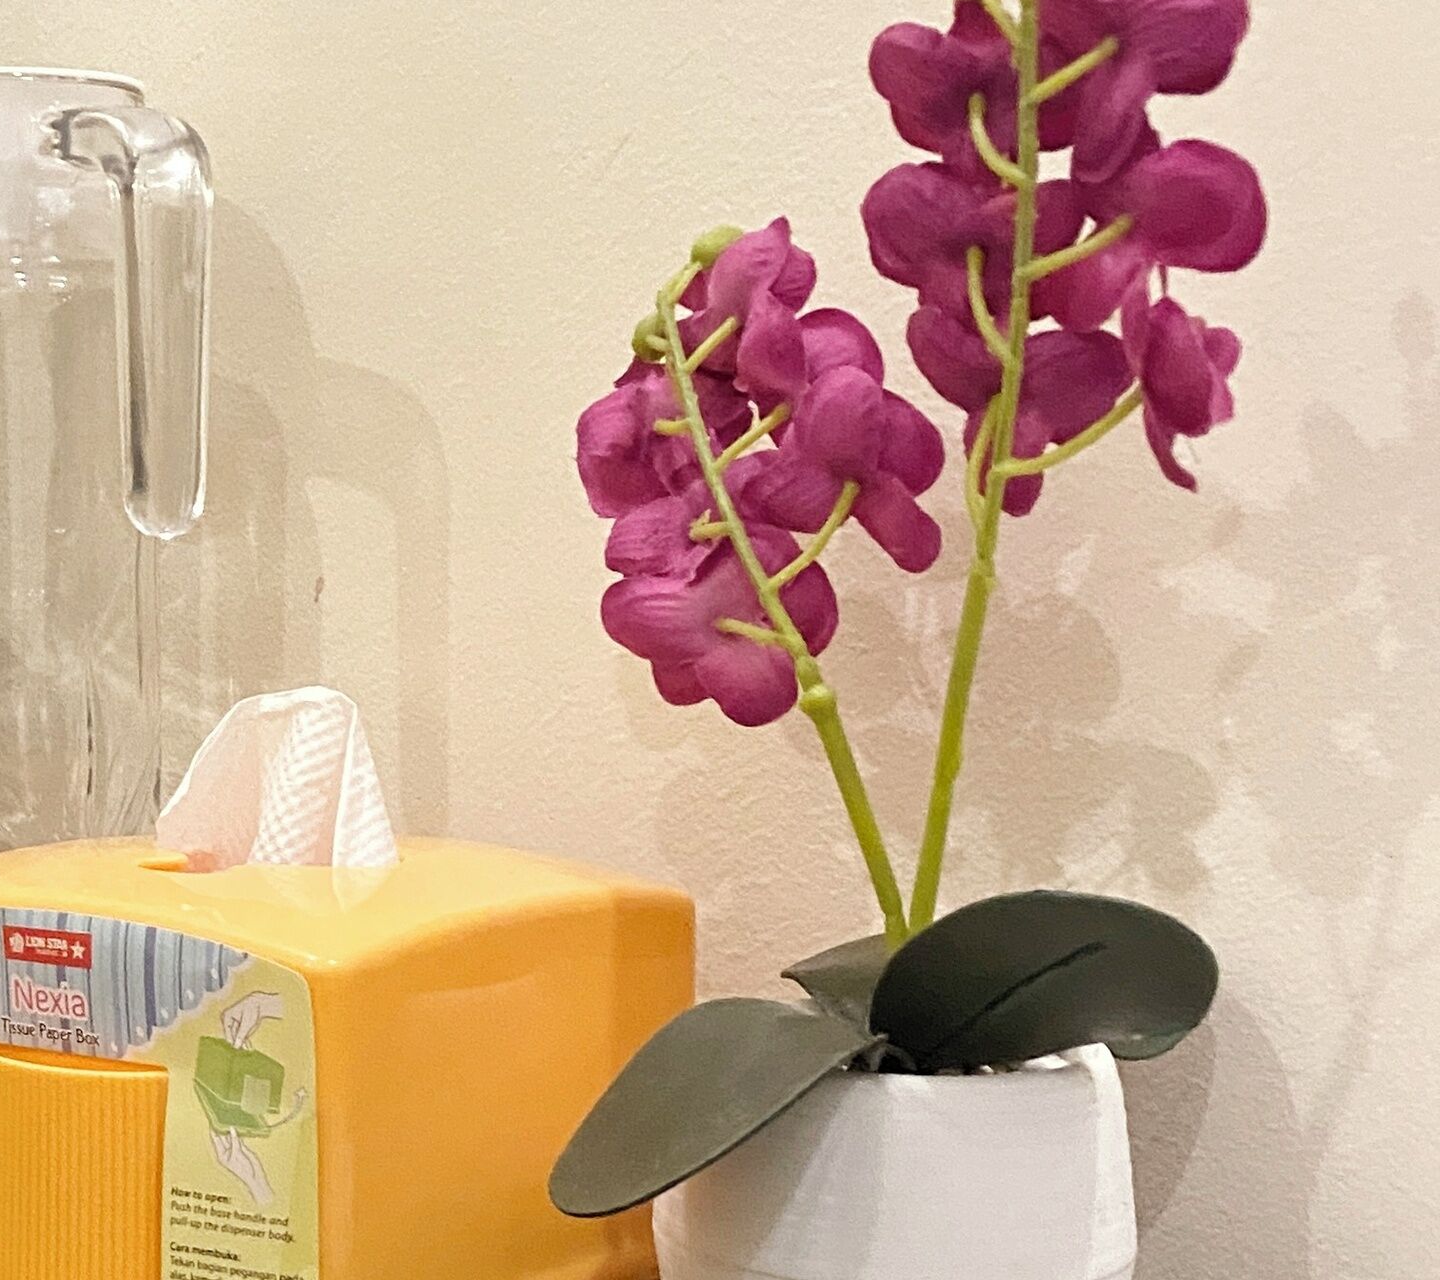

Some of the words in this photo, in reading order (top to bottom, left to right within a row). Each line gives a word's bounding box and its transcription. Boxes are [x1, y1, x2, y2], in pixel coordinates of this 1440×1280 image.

[12, 977, 87, 1018] Nexia
[1, 1017, 35, 1036] Tissue
[39, 1022, 72, 1044] Paper
[75, 1028, 100, 1046] Box
[171, 1187, 191, 1198] How
[193, 1190, 202, 1200] to
[171, 1200, 191, 1212] Push
[194, 1204, 208, 1215] the
[234, 1210, 266, 1224] handle
[269, 1217, 289, 1227] and
[204, 1221, 219, 1232] the
[221, 1224, 265, 1238] dispenser
[170, 1241, 190, 1253] Cara
[230, 1267, 277, 1280] pegangan
